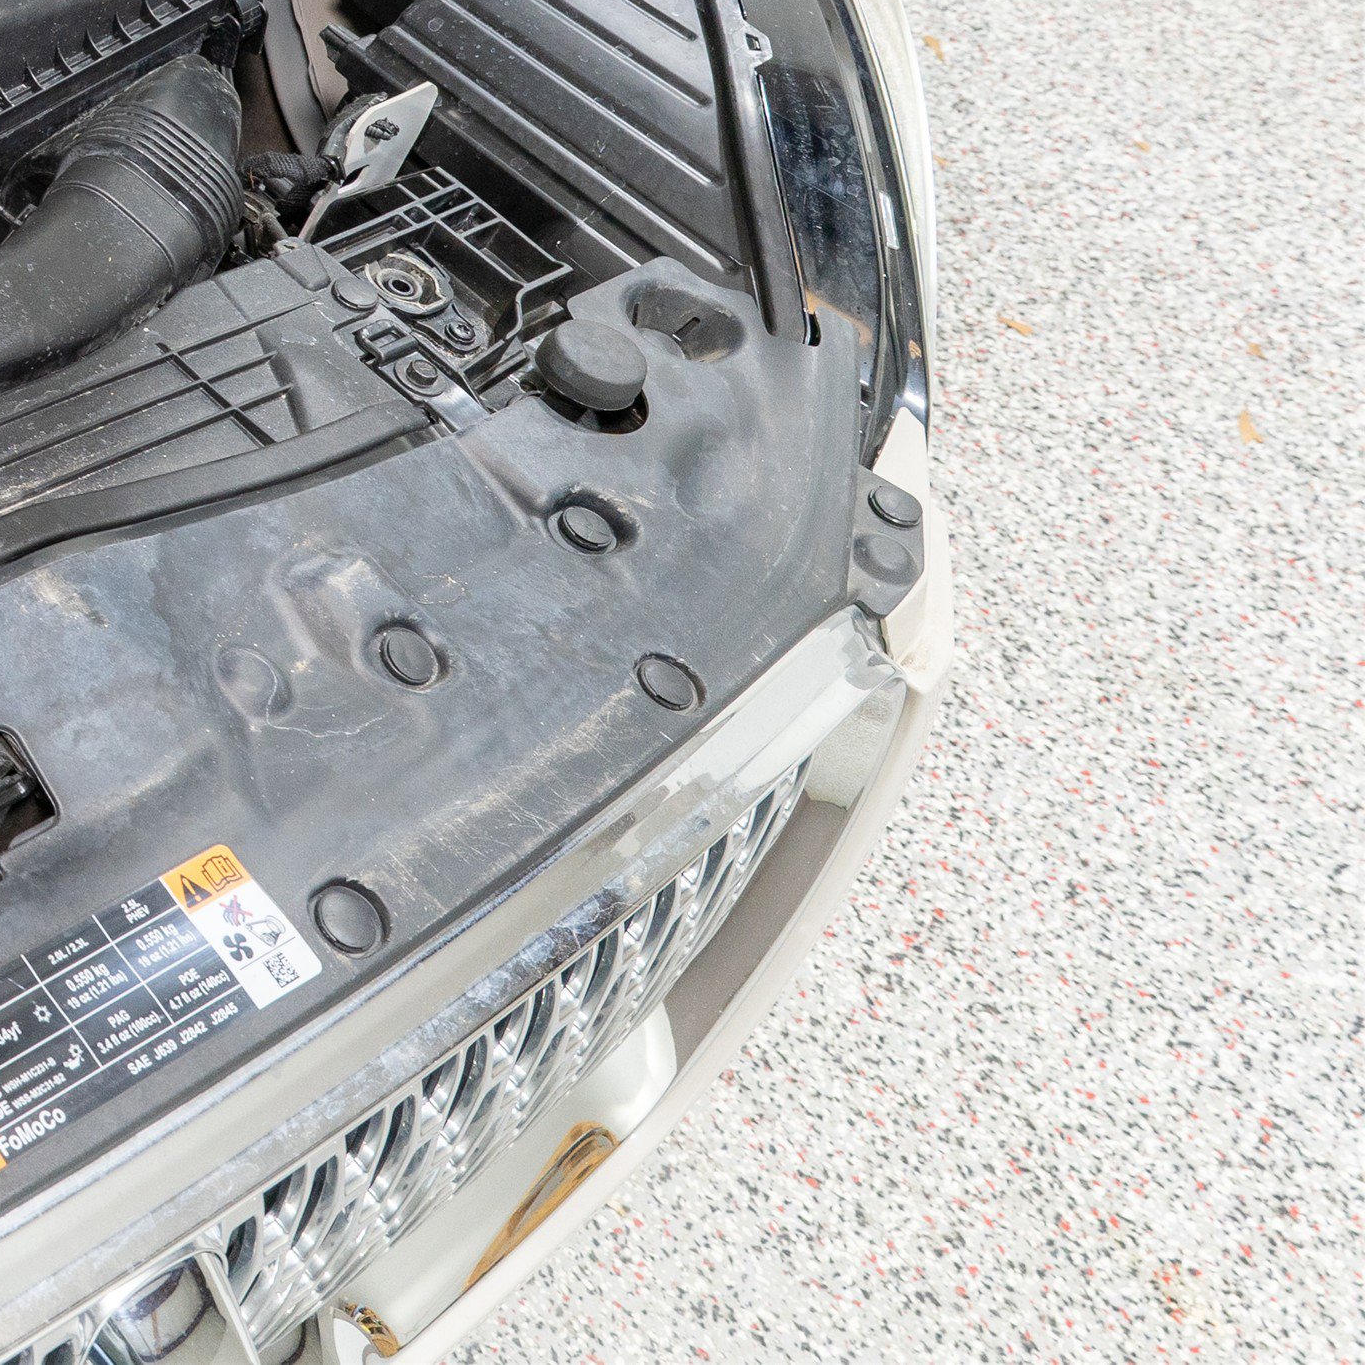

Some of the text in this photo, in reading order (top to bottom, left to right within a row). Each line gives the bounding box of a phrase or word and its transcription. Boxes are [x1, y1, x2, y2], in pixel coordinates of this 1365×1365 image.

[121, 898, 141, 913] 2.5L
[125, 904, 150, 924] PHEV
[135, 923, 178, 951] 0.550 kg
[137, 955, 152, 968] 19
[149, 950, 163, 963] oz
[65, 963, 110, 992] 0.550 kg
[178, 967, 200, 986] POE
[169, 995, 184, 1010] 4.7
[189, 987, 202, 1000] oz
[198, 969, 231, 995] (140cc)
[67, 996, 81, 1010] 19
[79, 992, 92, 1003] oz
[107, 1009, 131, 1029] PAG
[97, 1038, 113, 1054] 3.4
[118, 1029, 132, 1042] oz
[128, 1010, 162, 1038] (100cc)
[127, 1001, 239, 1075] SAE J639 J2842 J2845
